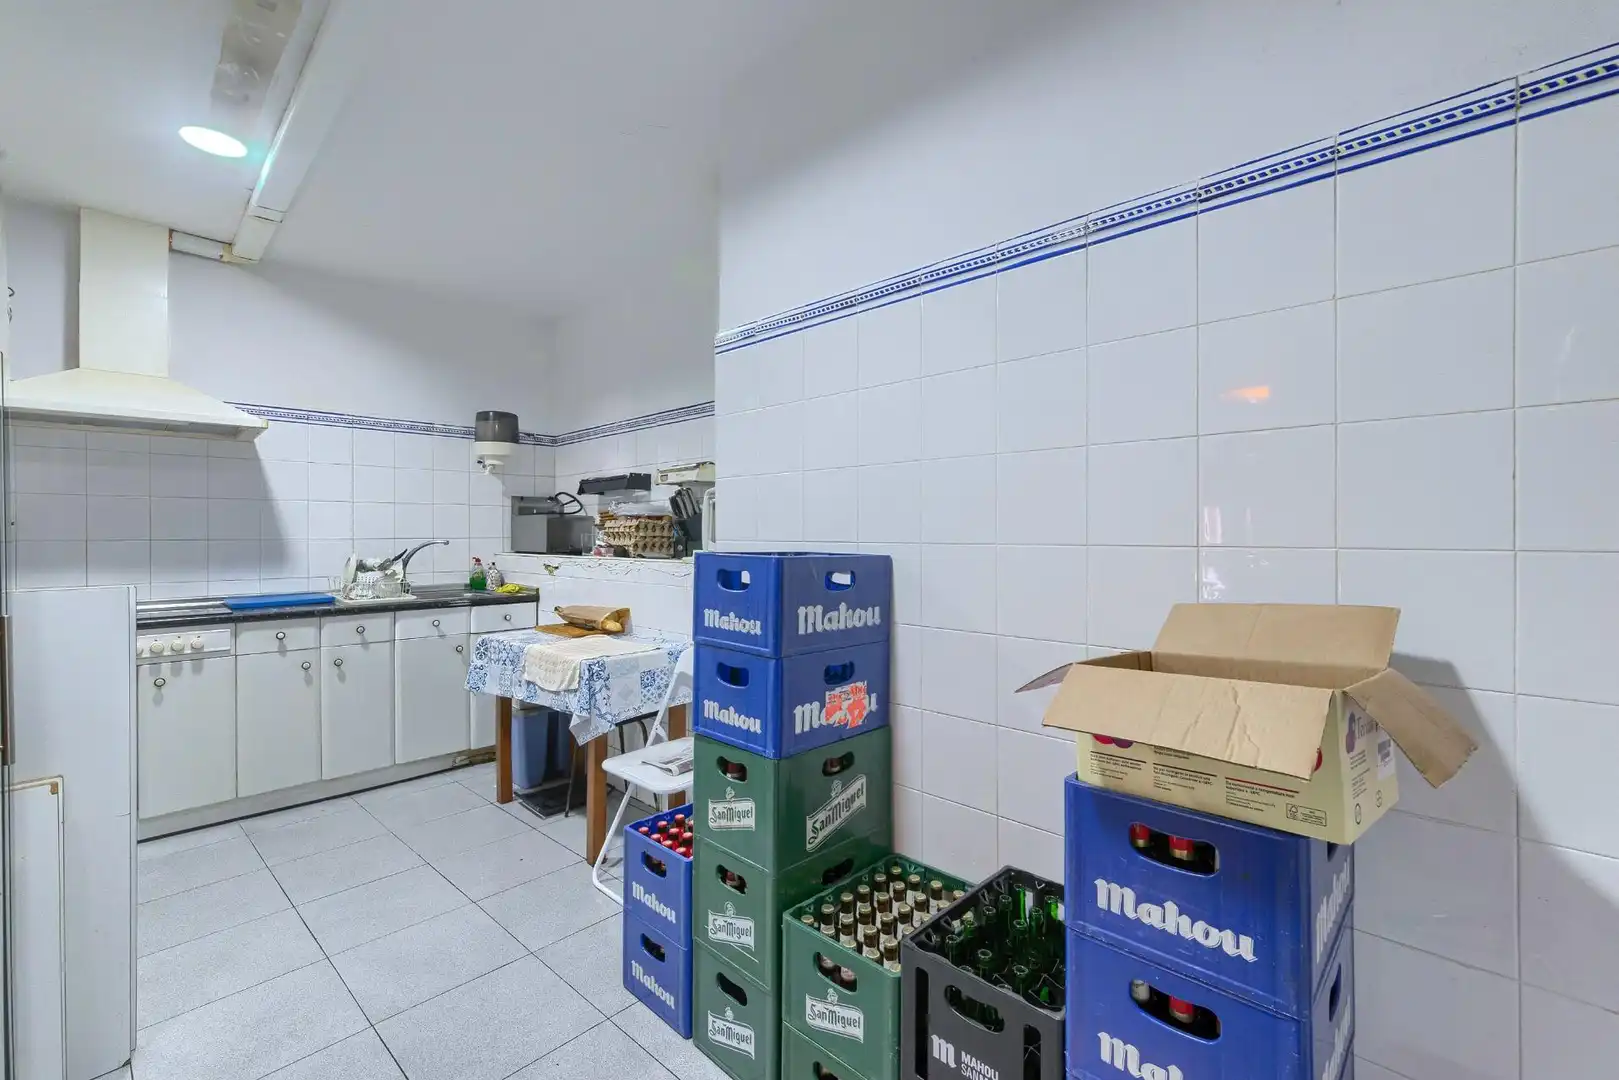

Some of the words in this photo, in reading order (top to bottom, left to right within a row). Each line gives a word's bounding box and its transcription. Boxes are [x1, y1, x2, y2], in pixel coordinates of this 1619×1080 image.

[703, 608, 762, 636] Mahou
[797, 602, 881, 635] Mahou
[703, 699, 762, 735] Mahou
[631, 880, 677, 924] Mahou
[1094, 877, 1258, 962] Mahou
[630, 959, 676, 1010] Mahou
[961, 1051, 999, 1080] MAHOU
